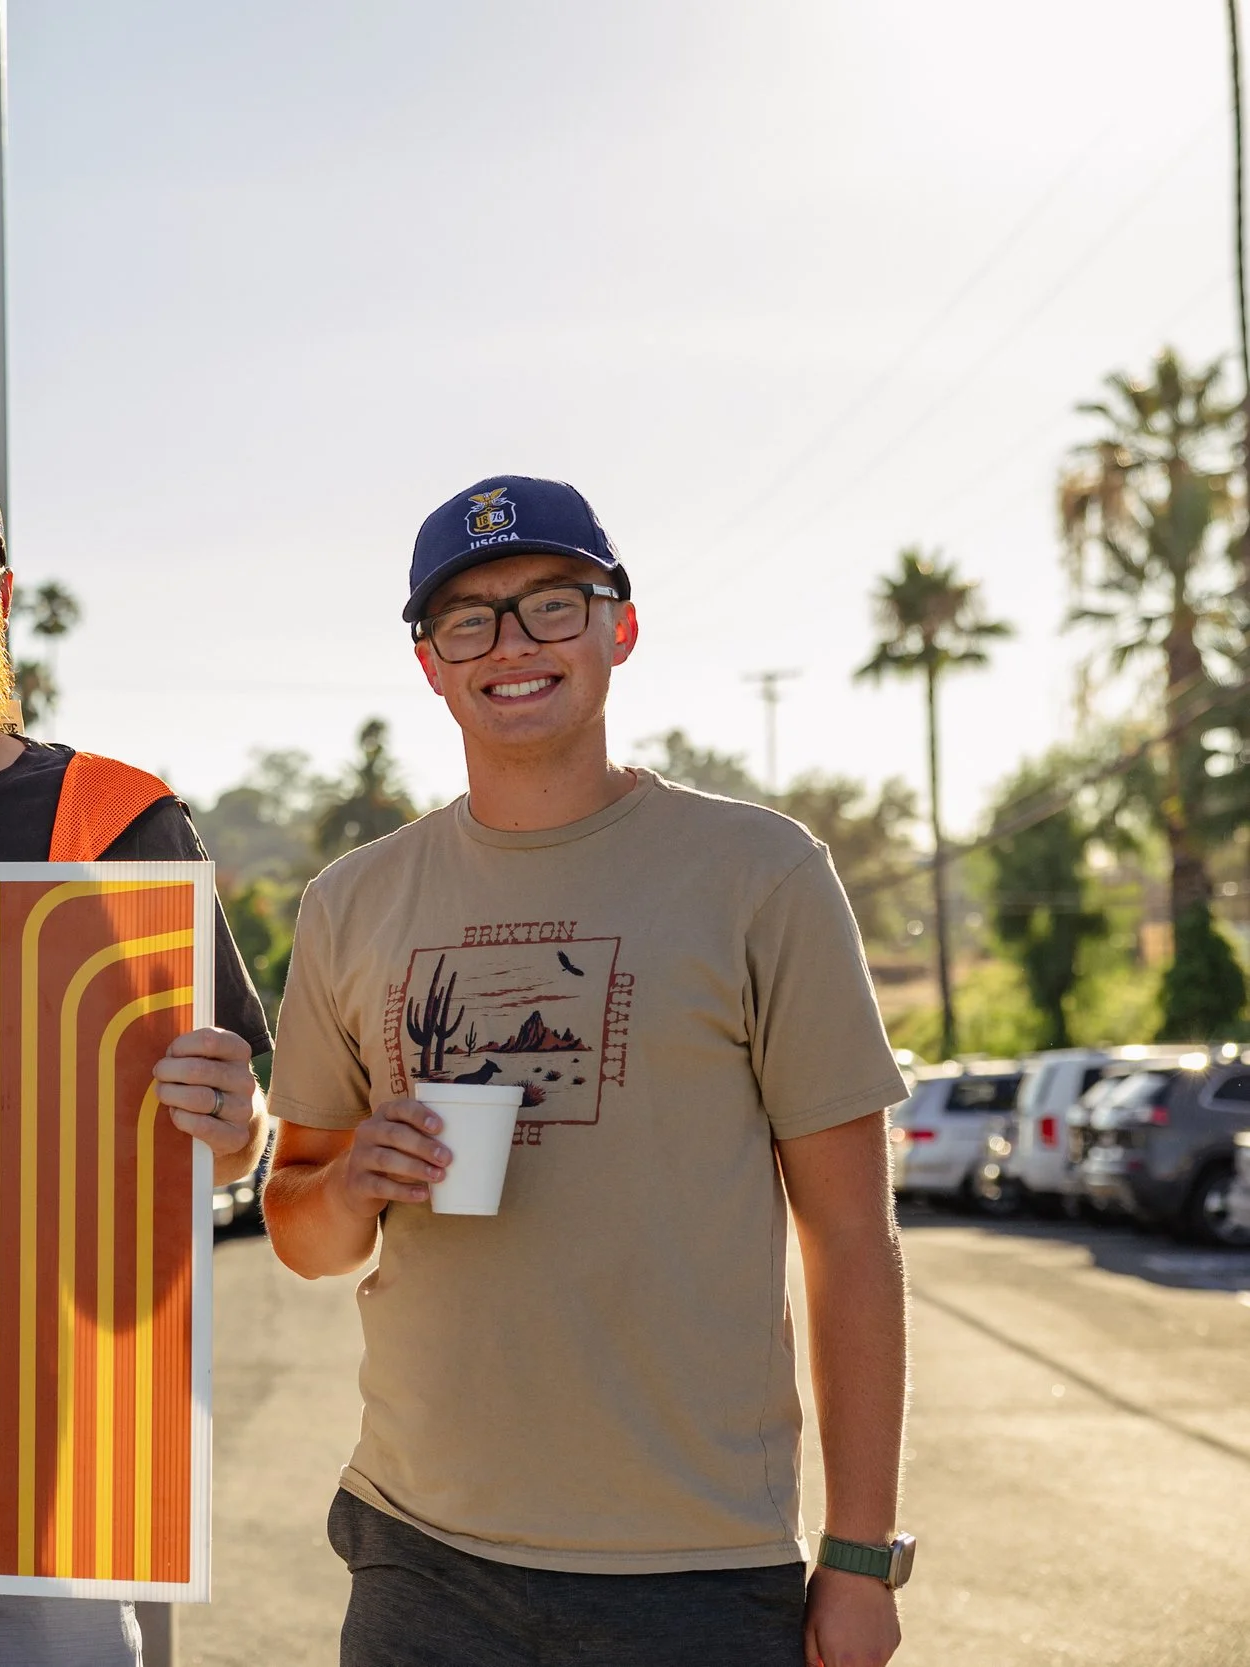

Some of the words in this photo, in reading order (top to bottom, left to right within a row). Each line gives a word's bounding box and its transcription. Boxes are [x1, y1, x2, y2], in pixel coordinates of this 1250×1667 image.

[470, 532, 520, 549] USCGA
[462, 921, 578, 947] BRIXTON
[384, 982, 406, 1095] GENUINE
[601, 972, 635, 1087] QUALITY
